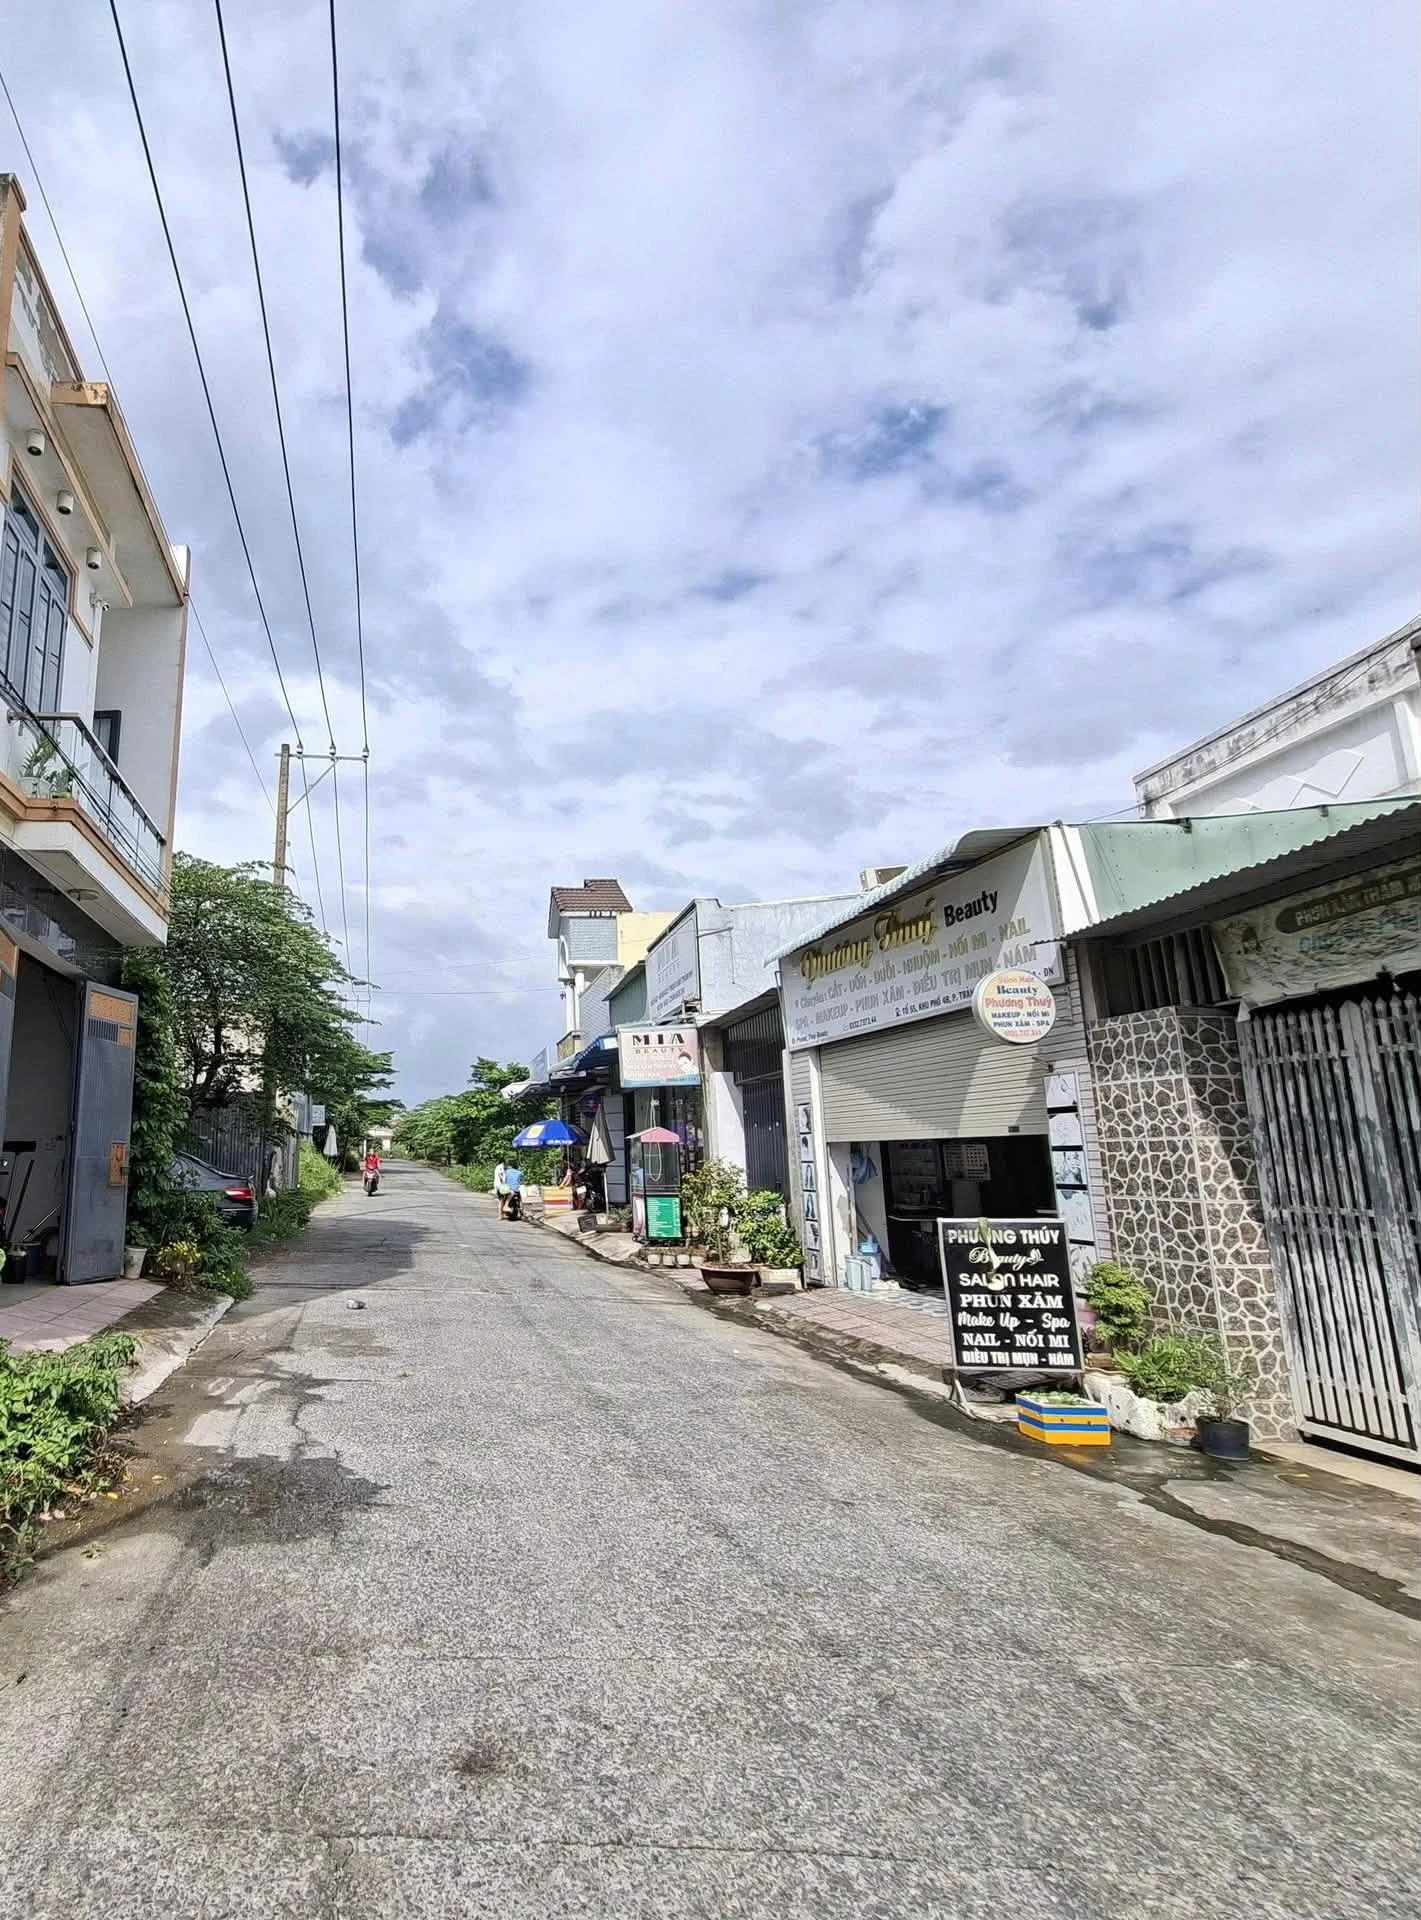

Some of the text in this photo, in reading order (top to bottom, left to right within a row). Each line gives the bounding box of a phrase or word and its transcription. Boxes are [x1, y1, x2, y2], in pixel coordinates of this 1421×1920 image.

[944, 889, 998, 927] Beauty
[998, 917, 1031, 943] NAIL
[997, 985, 1039, 996] Beauty
[815, 1003, 849, 1025] MAKEUP
[855, 992, 880, 1014] PHUN
[632, 1033, 684, 1046] MIA
[1020, 1225, 1060, 1245] THÚY
[968, 1246, 1028, 1271] Bauty
[1019, 1273, 1060, 1288] HAIR
[960, 1291, 1064, 1309] PHUN XĂM
[957, 1311, 996, 1327] Make
[999, 1312, 1021, 1332] Up
[1041, 1312, 1071, 1332] Spa
[961, 1332, 1000, 1346] NAIL
[1014, 1328, 1045, 1348] NỐI
[1048, 1334, 1070, 1348] MI
[990, 1351, 1010, 1367] TRỊ
[1011, 1352, 1039, 1367] MỤN
